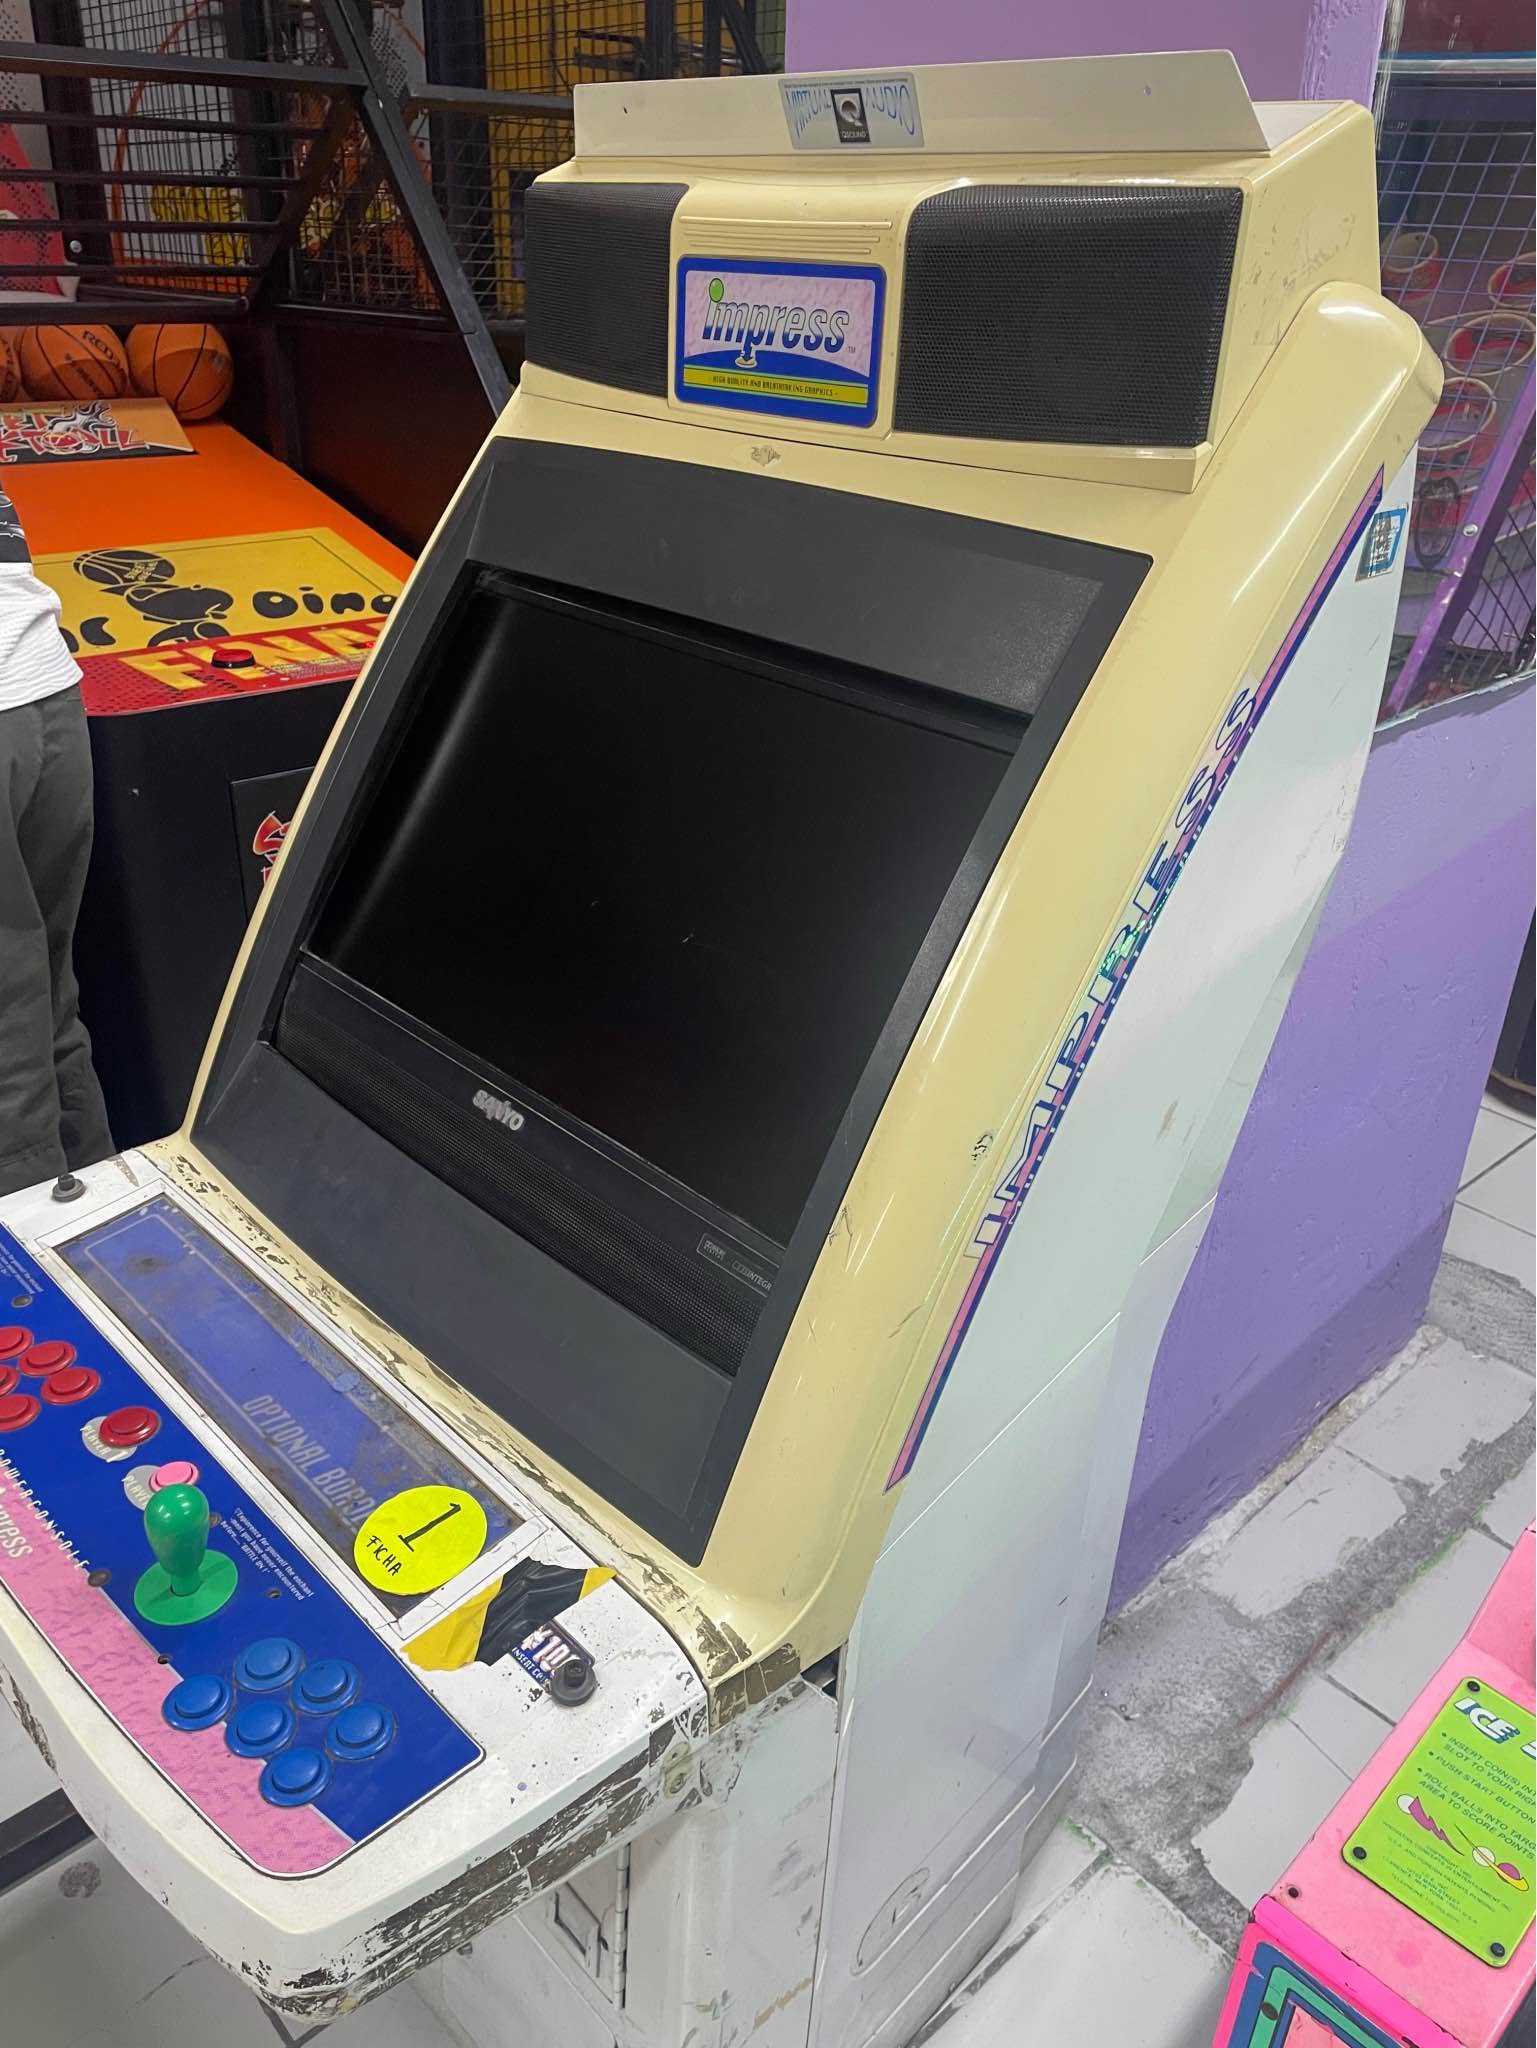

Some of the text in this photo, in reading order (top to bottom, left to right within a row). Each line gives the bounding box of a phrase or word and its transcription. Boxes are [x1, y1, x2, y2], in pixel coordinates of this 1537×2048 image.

[702, 277, 850, 361] impress
[974, 687, 1257, 1244] IMPRESS
[472, 1089, 525, 1131] SANYO
[243, 1395, 331, 1472] OPTIONAL
[398, 1502, 462, 1553] 1
[366, 1535, 402, 1577] FICHA
[511, 1646, 535, 1671] INSERT
[1454, 1697, 1520, 1744] ICE
[1443, 1744, 1469, 1763] SLOT
[1472, 1761, 1484, 1773] TO
[1486, 1771, 1515, 1792] YOUR
[1448, 1736, 1484, 1761] INSERT
[1418, 1780, 1446, 1801] AREA
[1448, 1799, 1461, 1811] TO
[1462, 1807, 1497, 1833] SCORE
[1423, 1772, 1449, 1793] ROLL
[1451, 1790, 1484, 1814] BALLS
[1484, 1812, 1508, 1831] INTO
